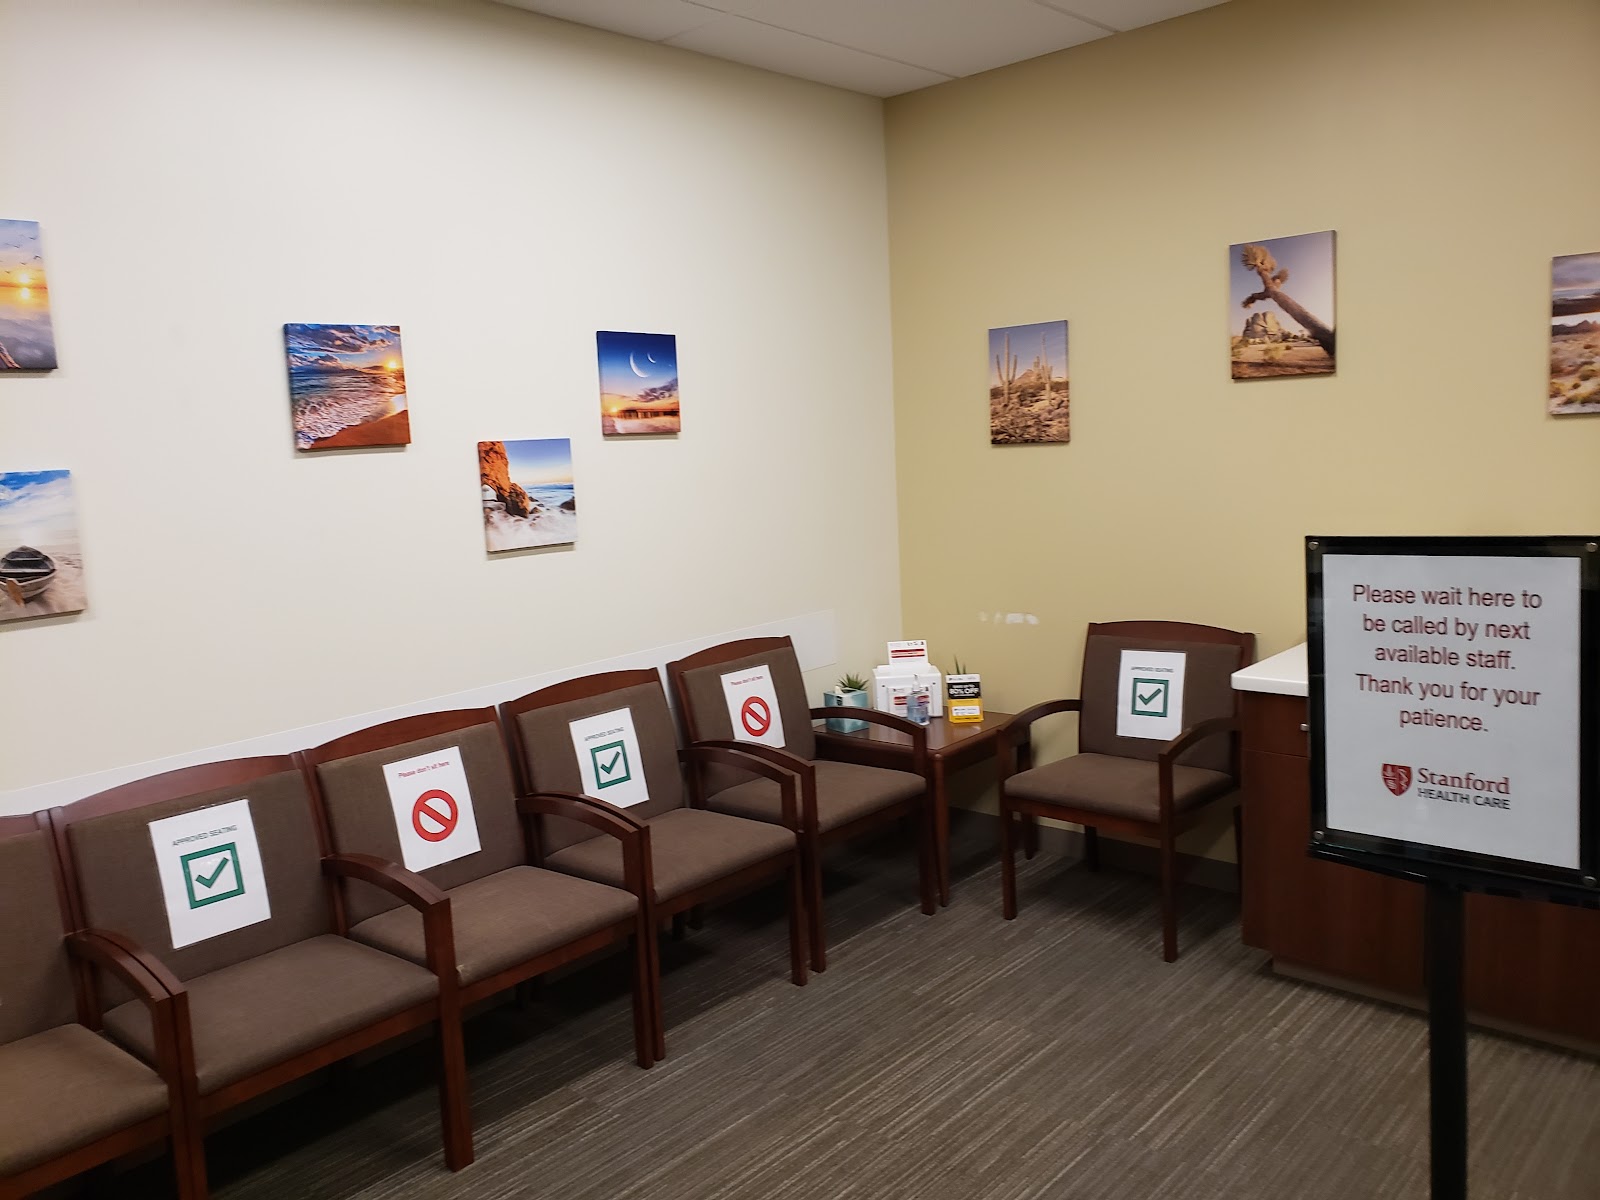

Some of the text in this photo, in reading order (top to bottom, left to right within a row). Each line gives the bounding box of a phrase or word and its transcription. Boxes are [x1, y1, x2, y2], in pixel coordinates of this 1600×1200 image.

[1353, 584, 1542, 609] Please wait here to
[1363, 614, 1530, 641] be called by next
[1375, 645, 1516, 670] available staff.
[1355, 673, 1541, 707] Thank you for your
[1400, 708, 1489, 732] patience.
[1417, 768, 1511, 795] Stanford
[1418, 788, 1511, 810] HEALTH CARE
[172, 825, 238, 846] APPROVED SEATING
